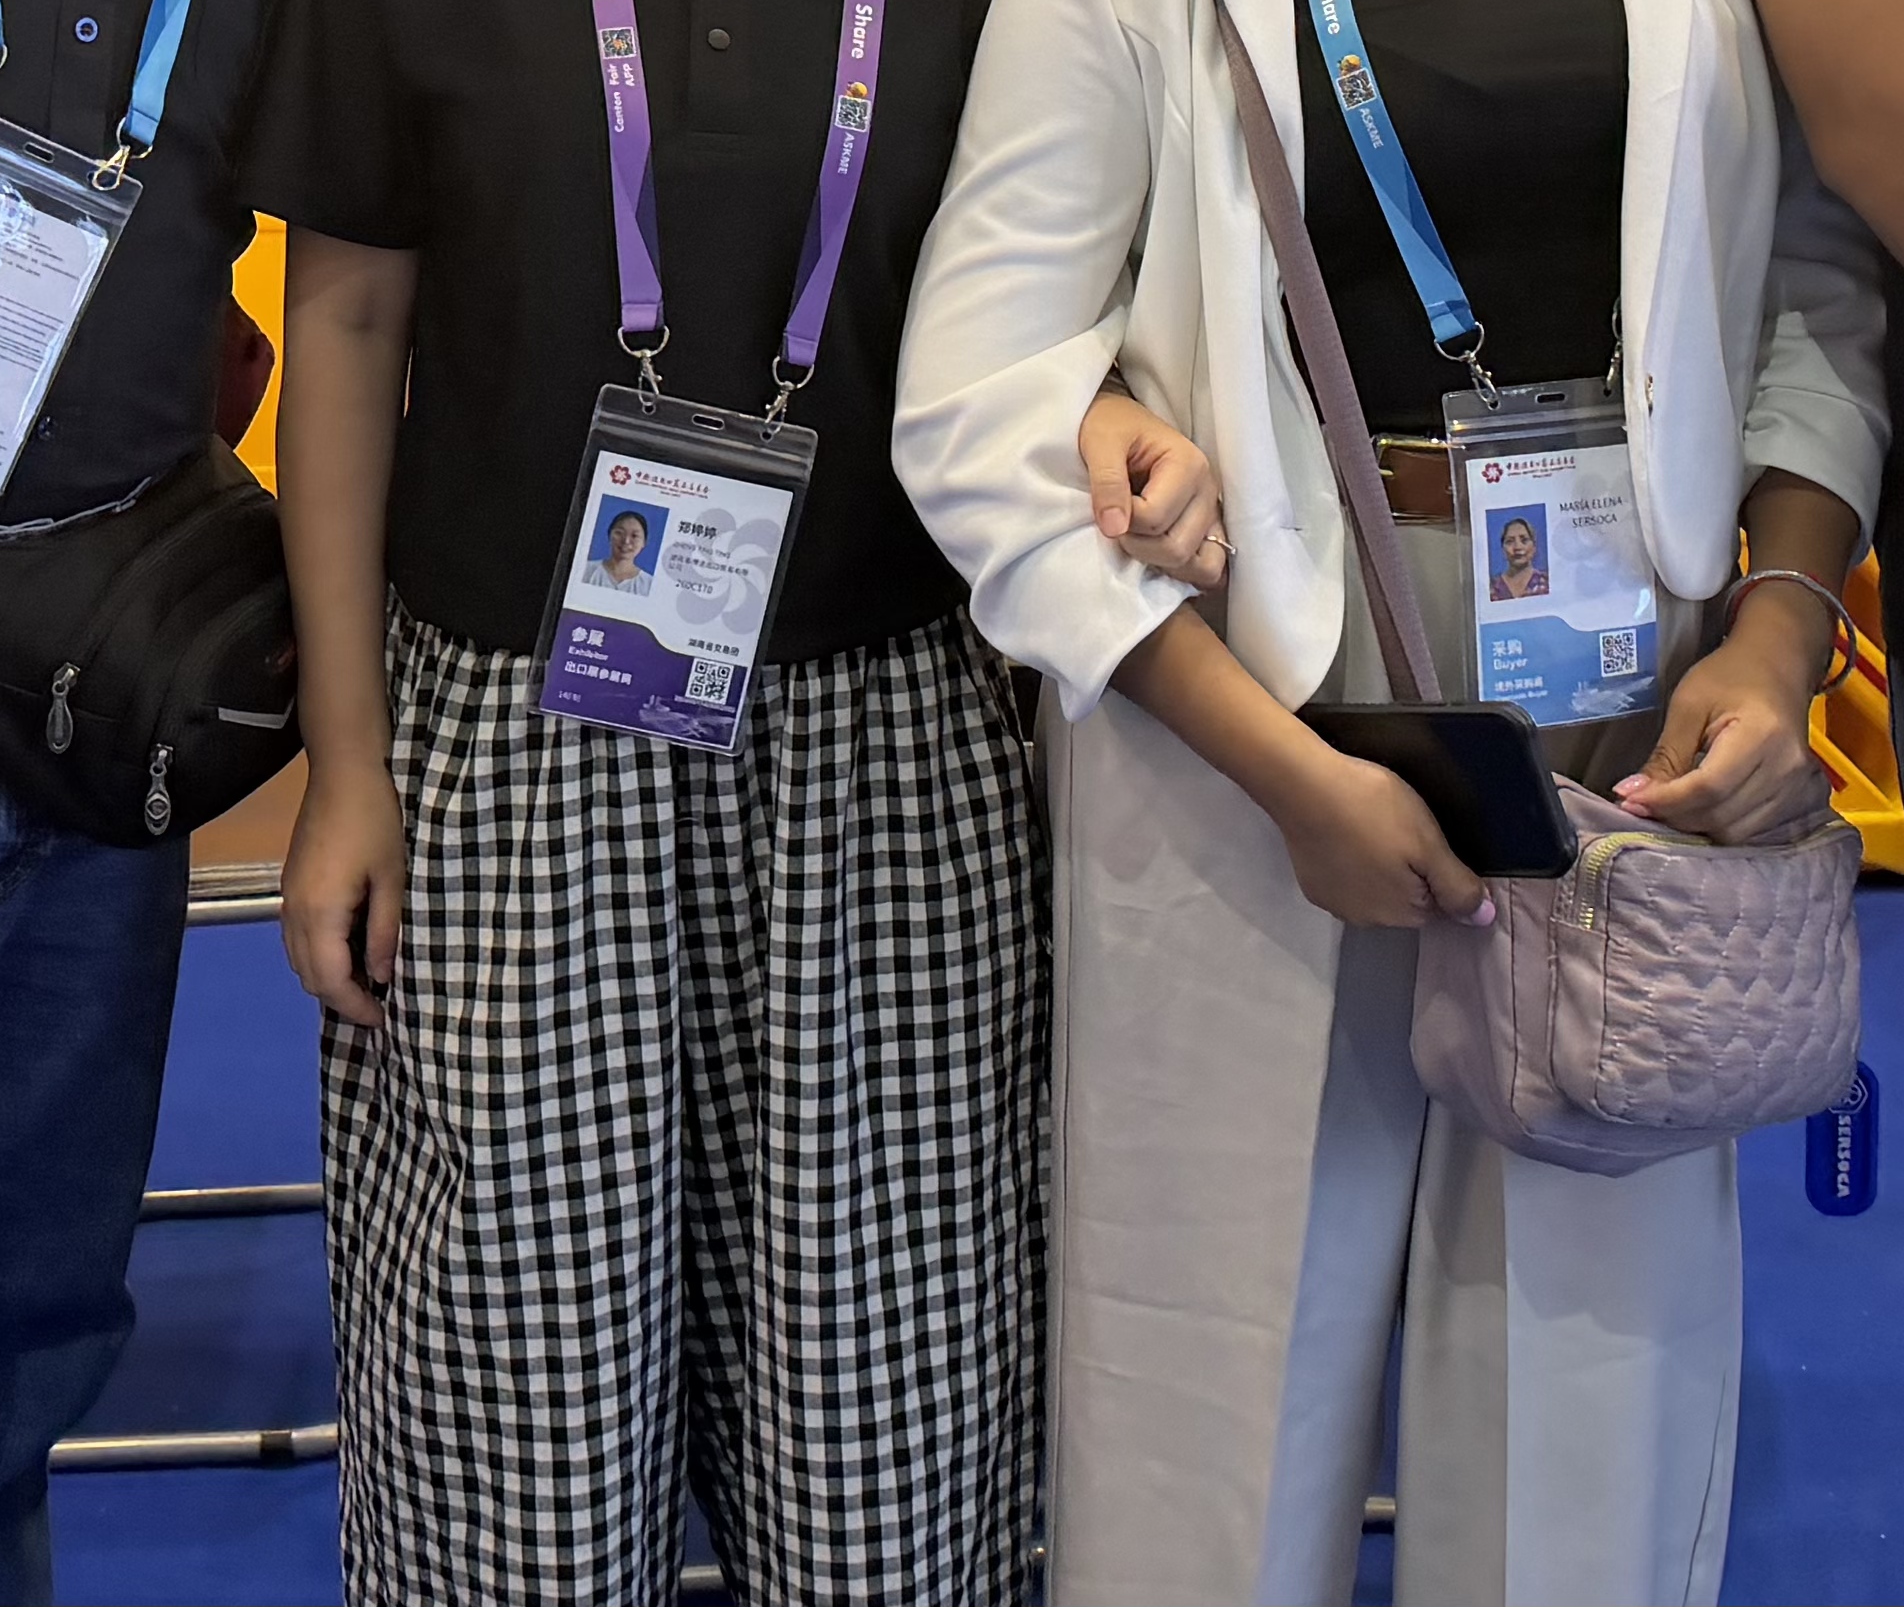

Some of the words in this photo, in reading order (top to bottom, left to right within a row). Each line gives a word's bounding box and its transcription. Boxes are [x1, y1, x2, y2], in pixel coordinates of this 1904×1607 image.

[850, 3, 874, 60] Share
[608, 63, 620, 87] Fair
[622, 63, 636, 87] APP
[613, 91, 625, 134] Canton
[1837, 1114, 1852, 1199] SERSOCA
